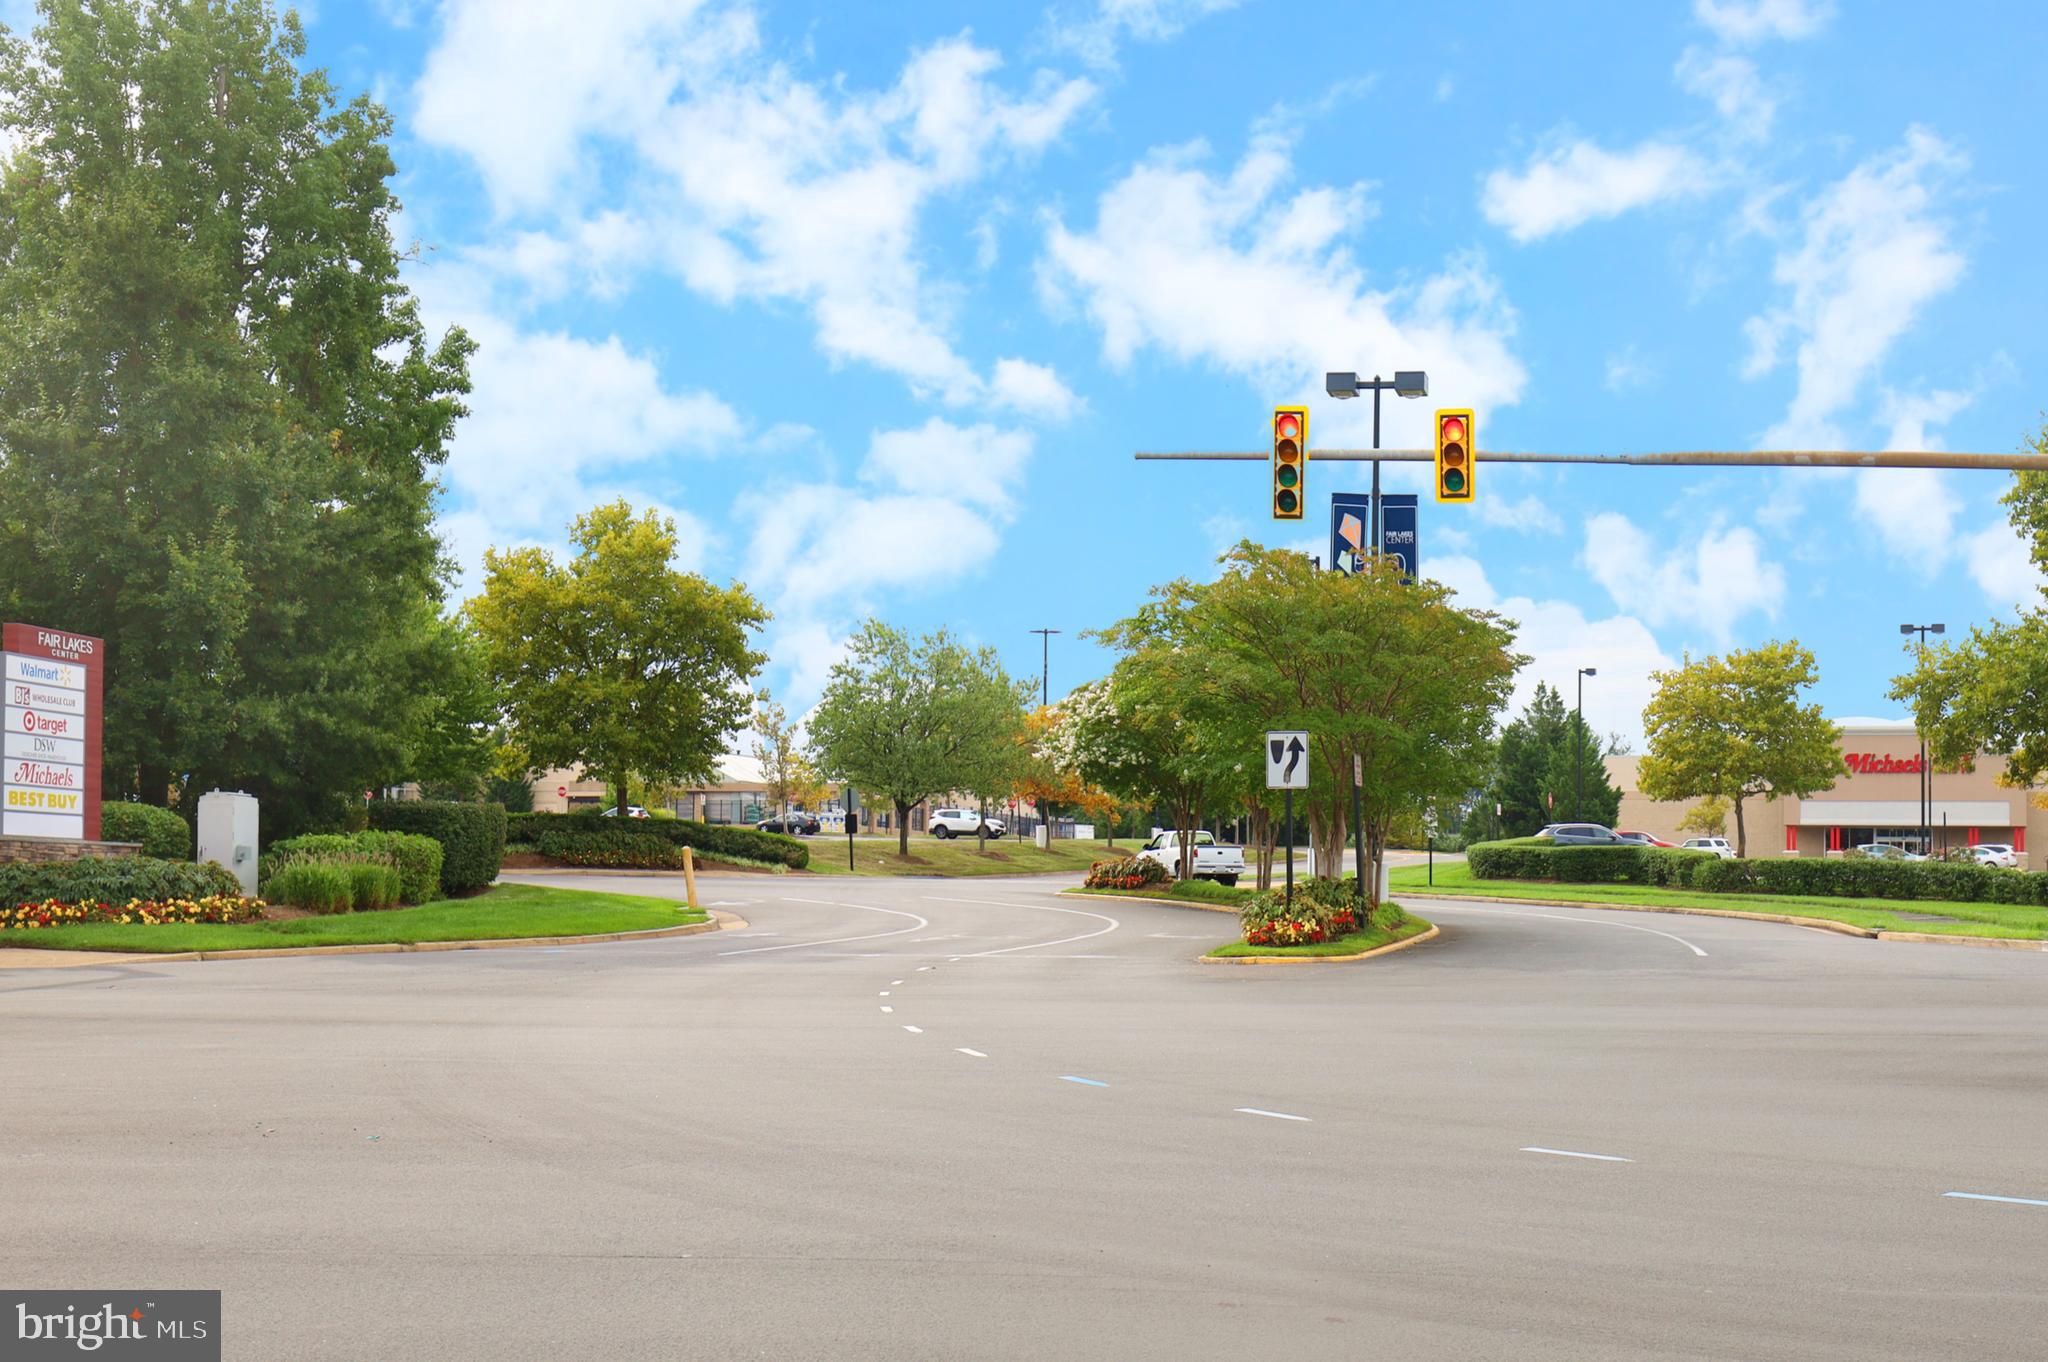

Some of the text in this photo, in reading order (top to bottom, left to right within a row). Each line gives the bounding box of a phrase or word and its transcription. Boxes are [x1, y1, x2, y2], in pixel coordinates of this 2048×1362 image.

[38, 632, 93, 654] FAIR LAKES
[51, 649, 79, 660] CENTER
[20, 662, 59, 681] Walmart
[32, 693, 62, 705] WHOLESALE
[63, 697, 76, 707] CLUB
[37, 716, 67, 735] target
[34, 738, 56, 752] DSW
[1844, 753, 1928, 774] Michaels
[14, 762, 73, 787] Michaels
[8, 790, 77, 809] BEST BUY
